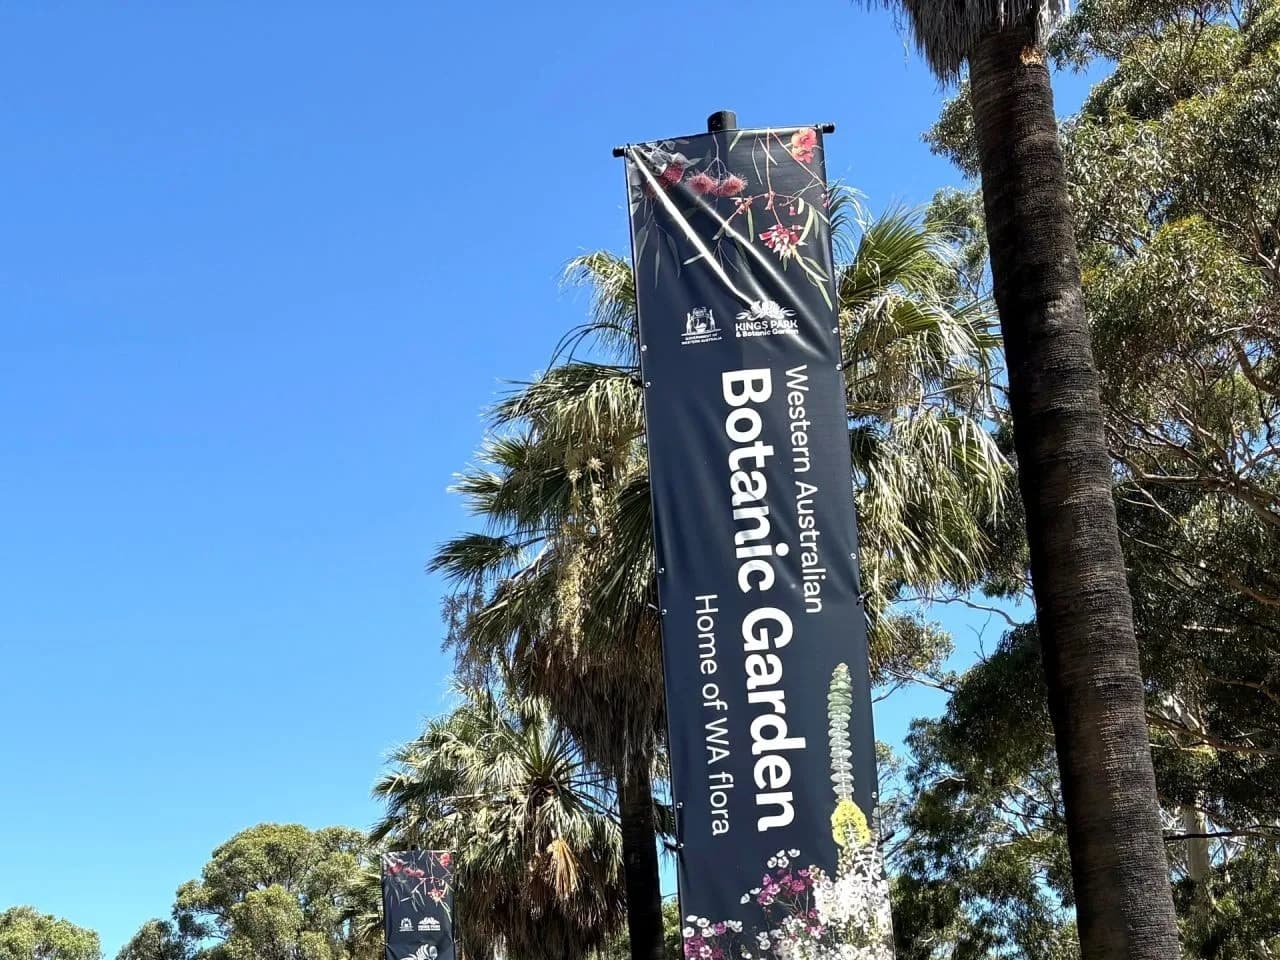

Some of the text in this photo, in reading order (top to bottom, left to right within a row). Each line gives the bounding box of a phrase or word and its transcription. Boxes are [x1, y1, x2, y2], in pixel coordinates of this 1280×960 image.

[735, 319, 798, 331] KINGS PARK
[743, 329, 771, 338] Botanic
[721, 367, 807, 832] Botanic Garden
[784, 364, 824, 614] Western Australian
[695, 594, 735, 836] Home of WA flora
